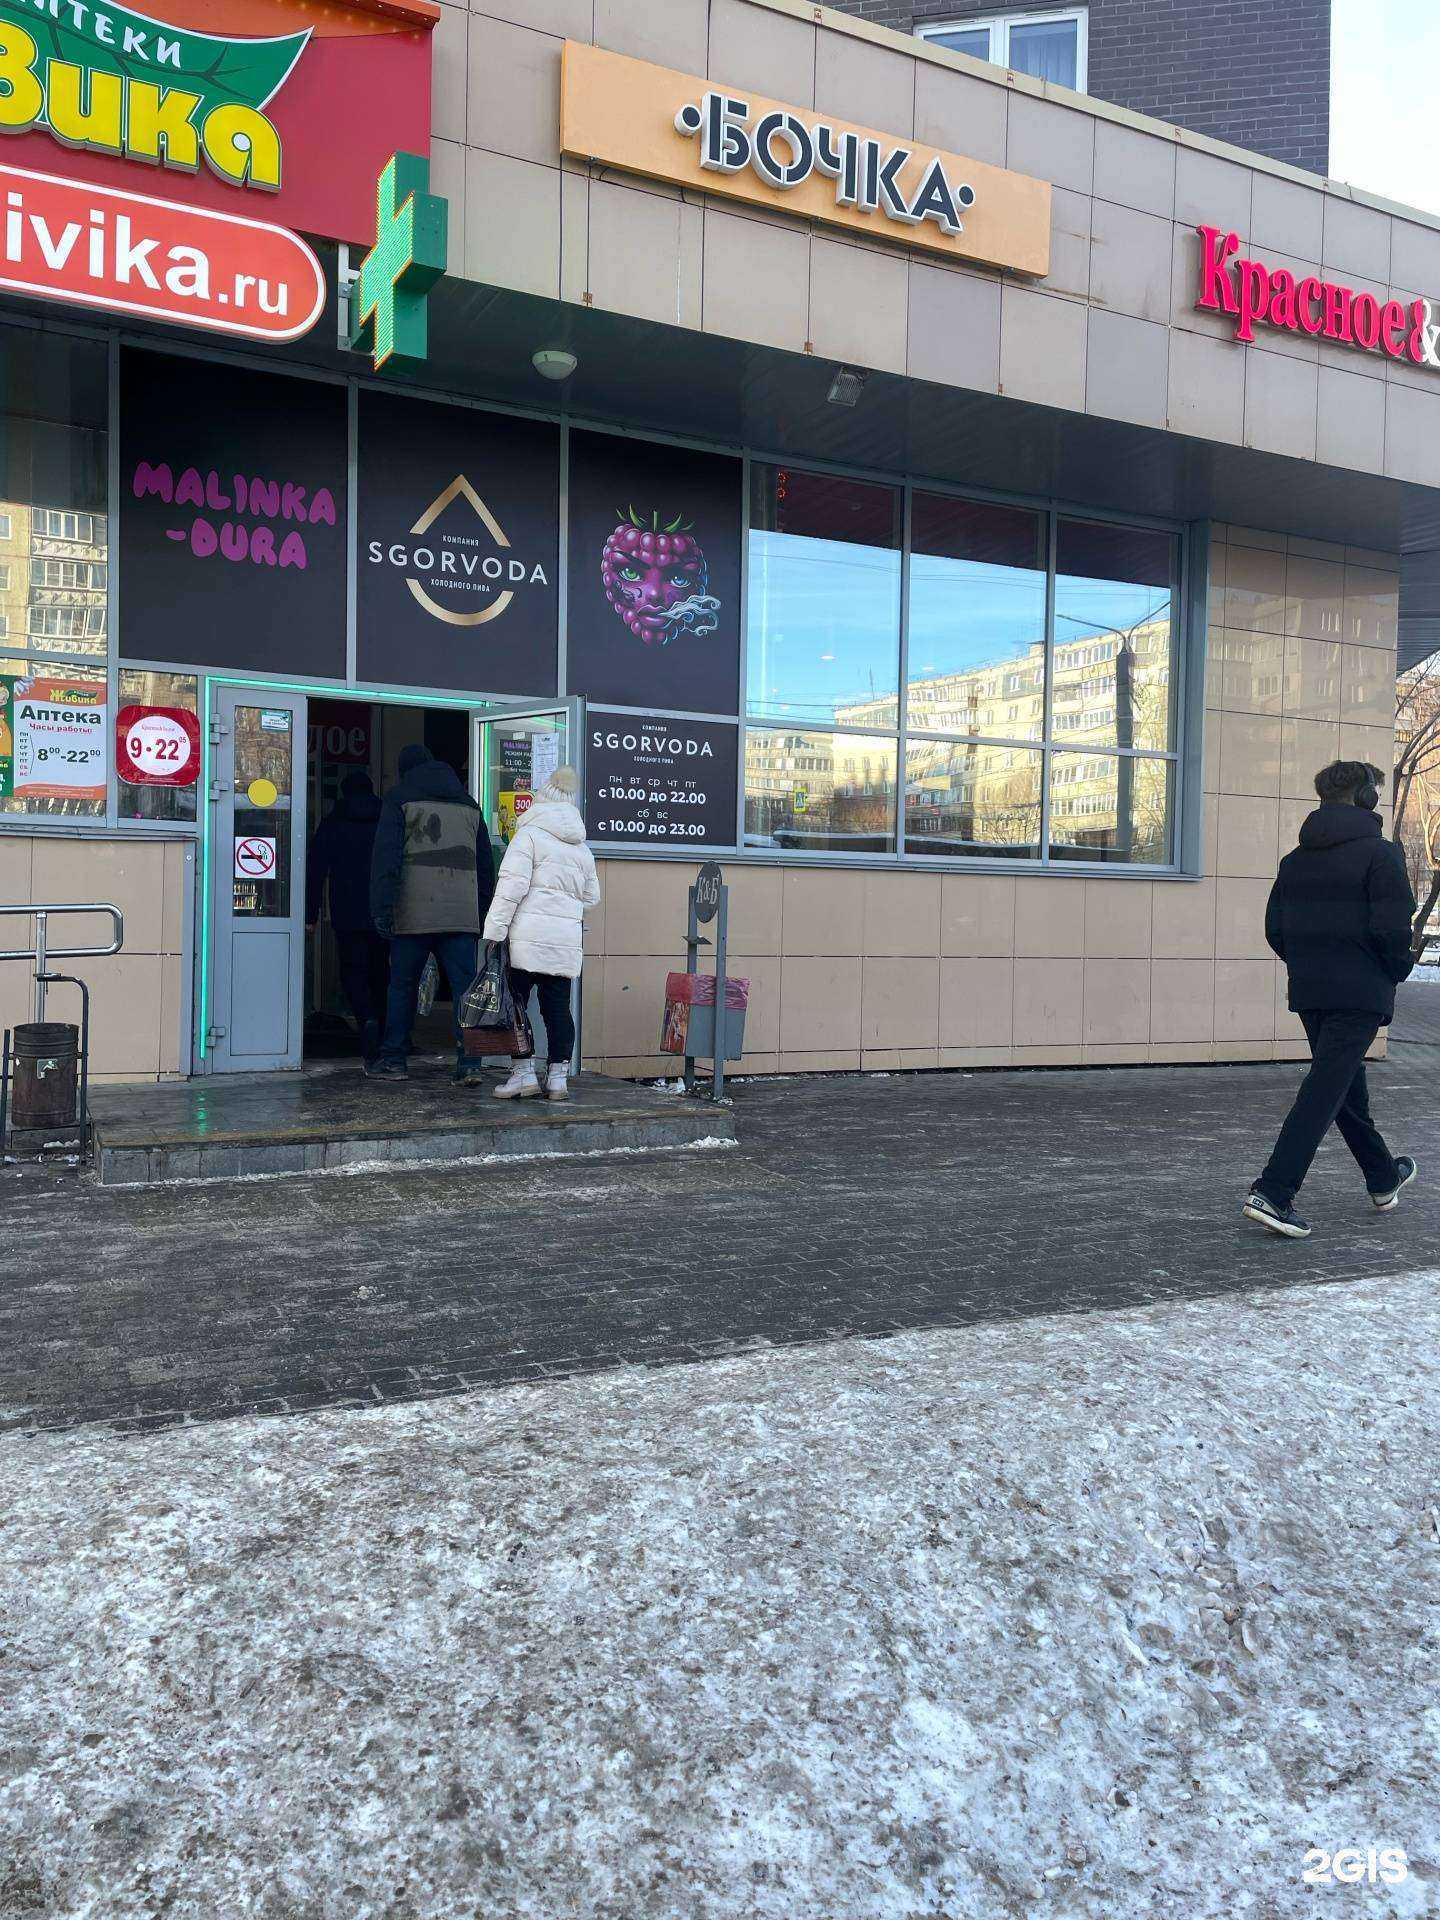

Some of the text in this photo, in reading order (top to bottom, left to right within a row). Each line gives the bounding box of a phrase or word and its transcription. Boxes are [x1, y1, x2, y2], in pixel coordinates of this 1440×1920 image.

[700, 90, 965, 236] БОЧКА
[133, 461, 337, 526] MALINKA
[442, 534, 479, 547] КОМПАНИЯ
[368, 541, 548, 585] SGORVODA
[430, 578, 490, 592] ХОЛОДНОГО ПИВА
[20, 705, 102, 724] Аптека
[29, 723, 54, 731] Часы
[593, 732, 713, 757] SGORVODA
[648, 778, 661, 787] ср
[667, 779, 678, 787] чт
[610, 787, 646, 800] 10.00
[649, 792, 667, 803] до
[670, 791, 707, 804] 22.00
[637, 808, 669, 819] сб вс
[609, 819, 645, 833] 10.00
[648, 824, 667, 835] до
[669, 823, 706, 836] 23.00
